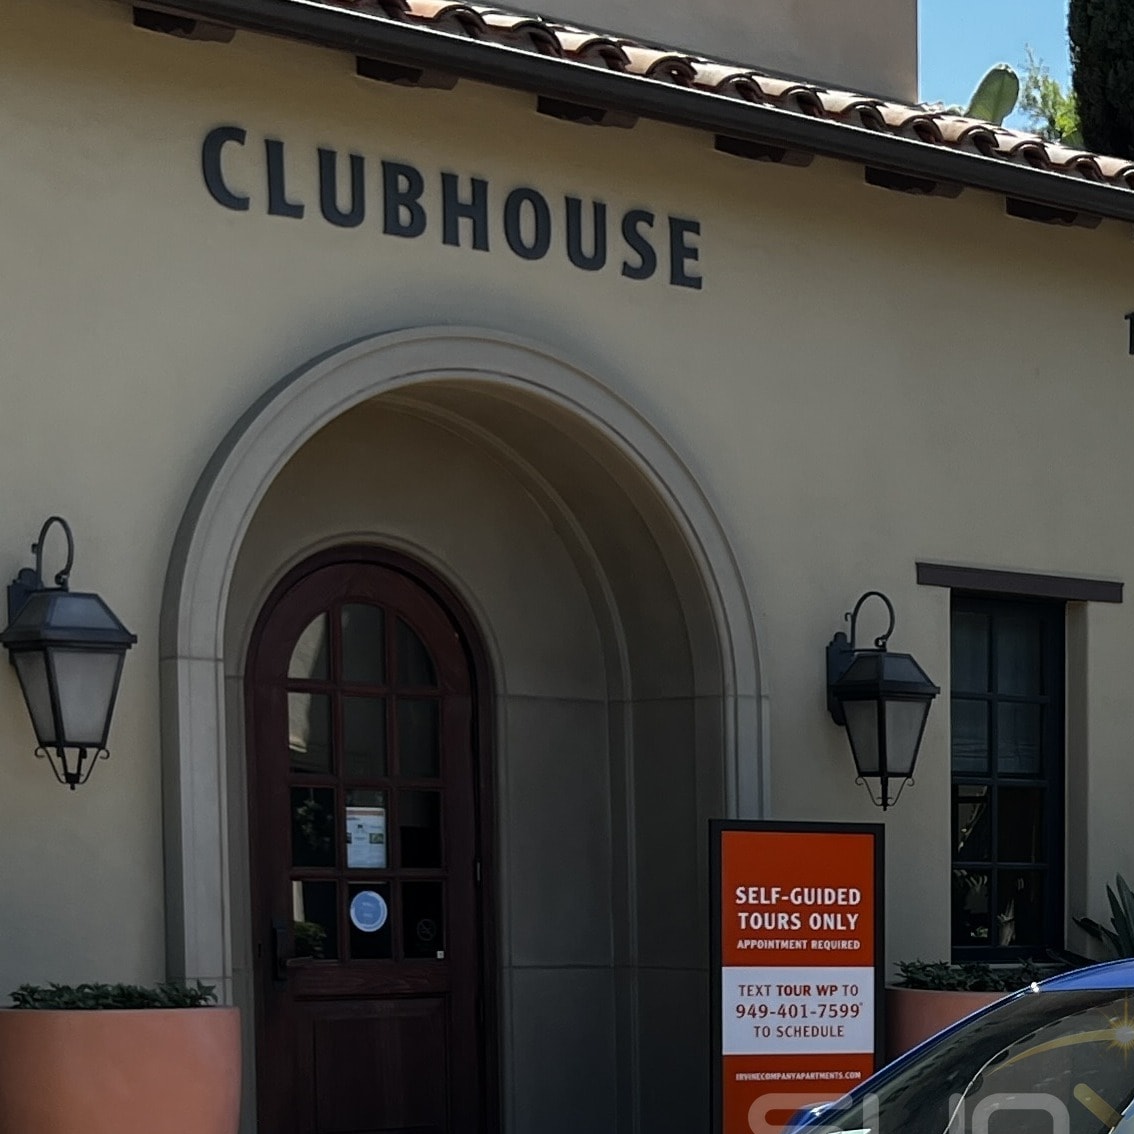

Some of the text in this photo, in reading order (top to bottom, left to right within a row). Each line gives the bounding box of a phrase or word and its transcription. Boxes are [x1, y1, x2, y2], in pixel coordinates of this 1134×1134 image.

[201, 126, 703, 289] CLUBHOUSE
[735, 886, 861, 905] SELF-GUIDED
[738, 912, 859, 930] TOURS ONLY
[736, 939, 861, 951] APPOINTMENT REQUIRED
[738, 984, 859, 997] TEXT TOUR WP TO
[753, 1025, 845, 1038] TO SCHEDULE
[735, 1071, 861, 1081] IRVINECOMPANYAPARTMENTS.COM
